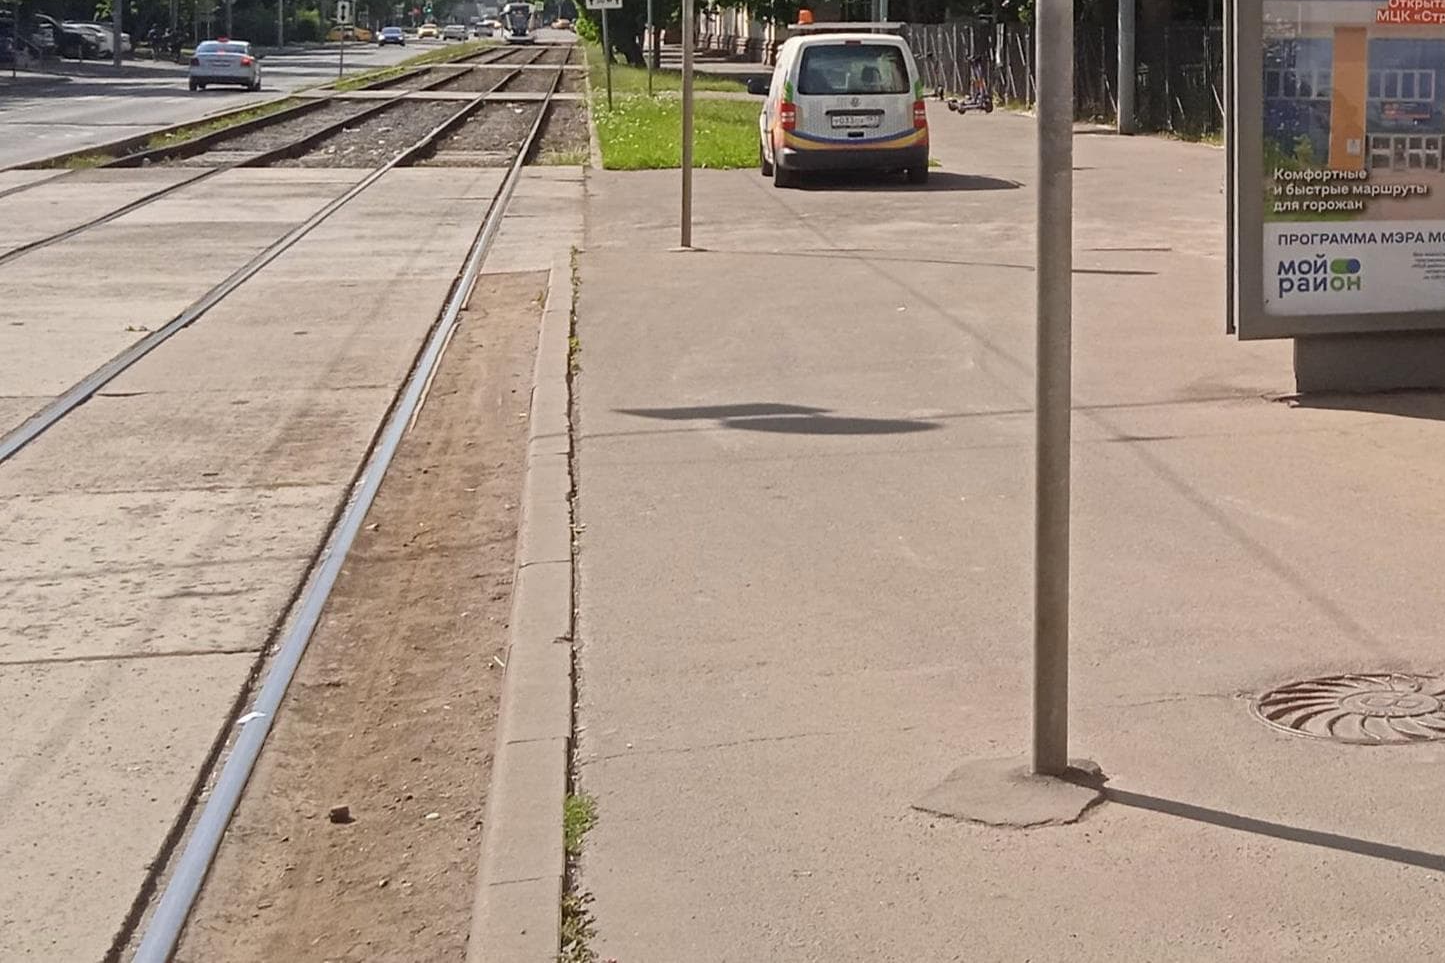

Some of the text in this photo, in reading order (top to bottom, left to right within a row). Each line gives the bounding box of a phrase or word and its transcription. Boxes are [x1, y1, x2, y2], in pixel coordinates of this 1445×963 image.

[1377, 10, 1410, 23] МЦК
[1273, 168, 1367, 181] Комфортные
[1273, 184, 1428, 196] и быстрые маршруты
[1273, 200, 1363, 212] для горожан
[1278, 233, 1377, 246] ПРОГРАММА
[1381, 232, 1424, 244] МЭРА
[1277, 253, 1327, 275] мой
